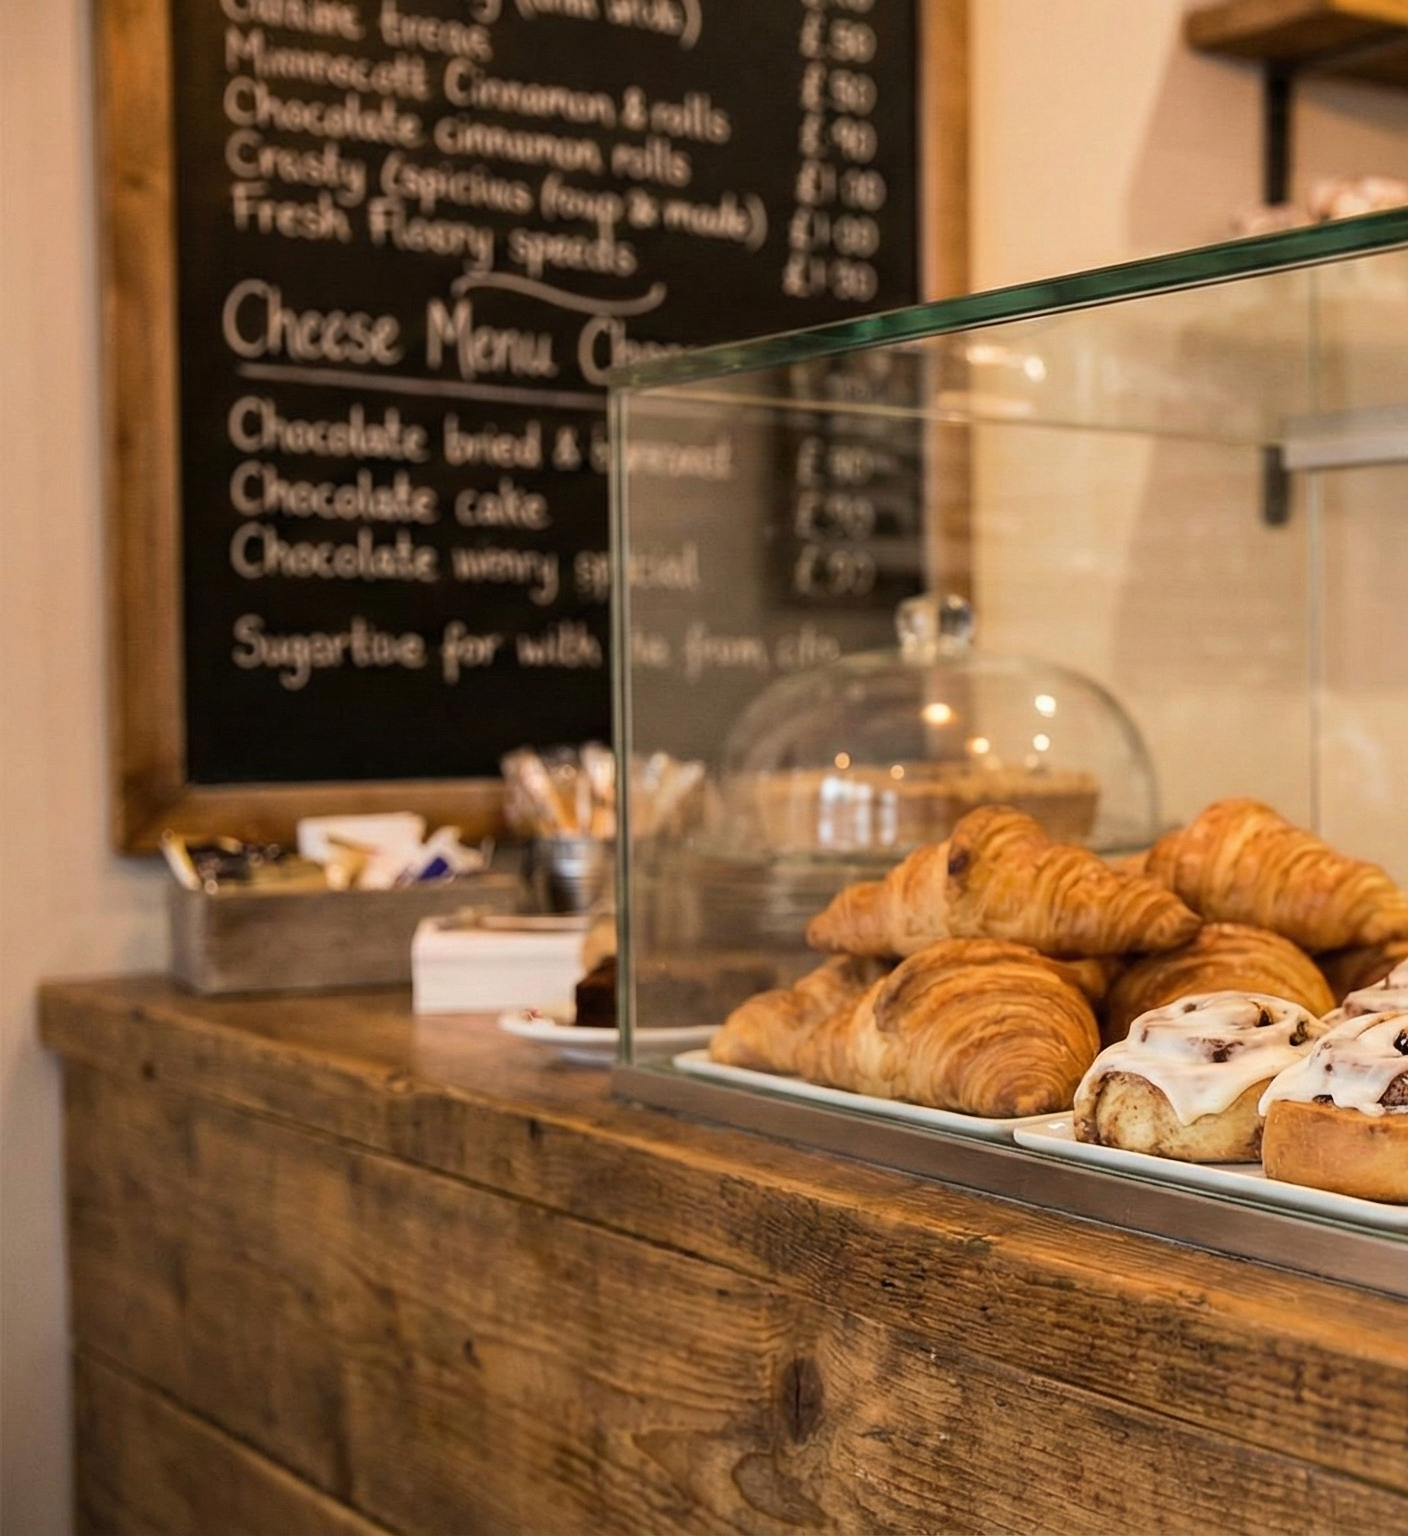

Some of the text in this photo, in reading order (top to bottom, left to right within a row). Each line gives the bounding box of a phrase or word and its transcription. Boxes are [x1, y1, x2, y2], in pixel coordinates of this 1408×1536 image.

[223, 75, 425, 149] Chocolate
[230, 180, 354, 245] Fresh
[222, 278, 404, 366] Cheese
[426, 296, 561, 382] Menu
[227, 395, 430, 463] Chocolate
[229, 459, 553, 532] Chocolate cake
[229, 520, 440, 584] Chocolate
[440, 619, 502, 687] for
